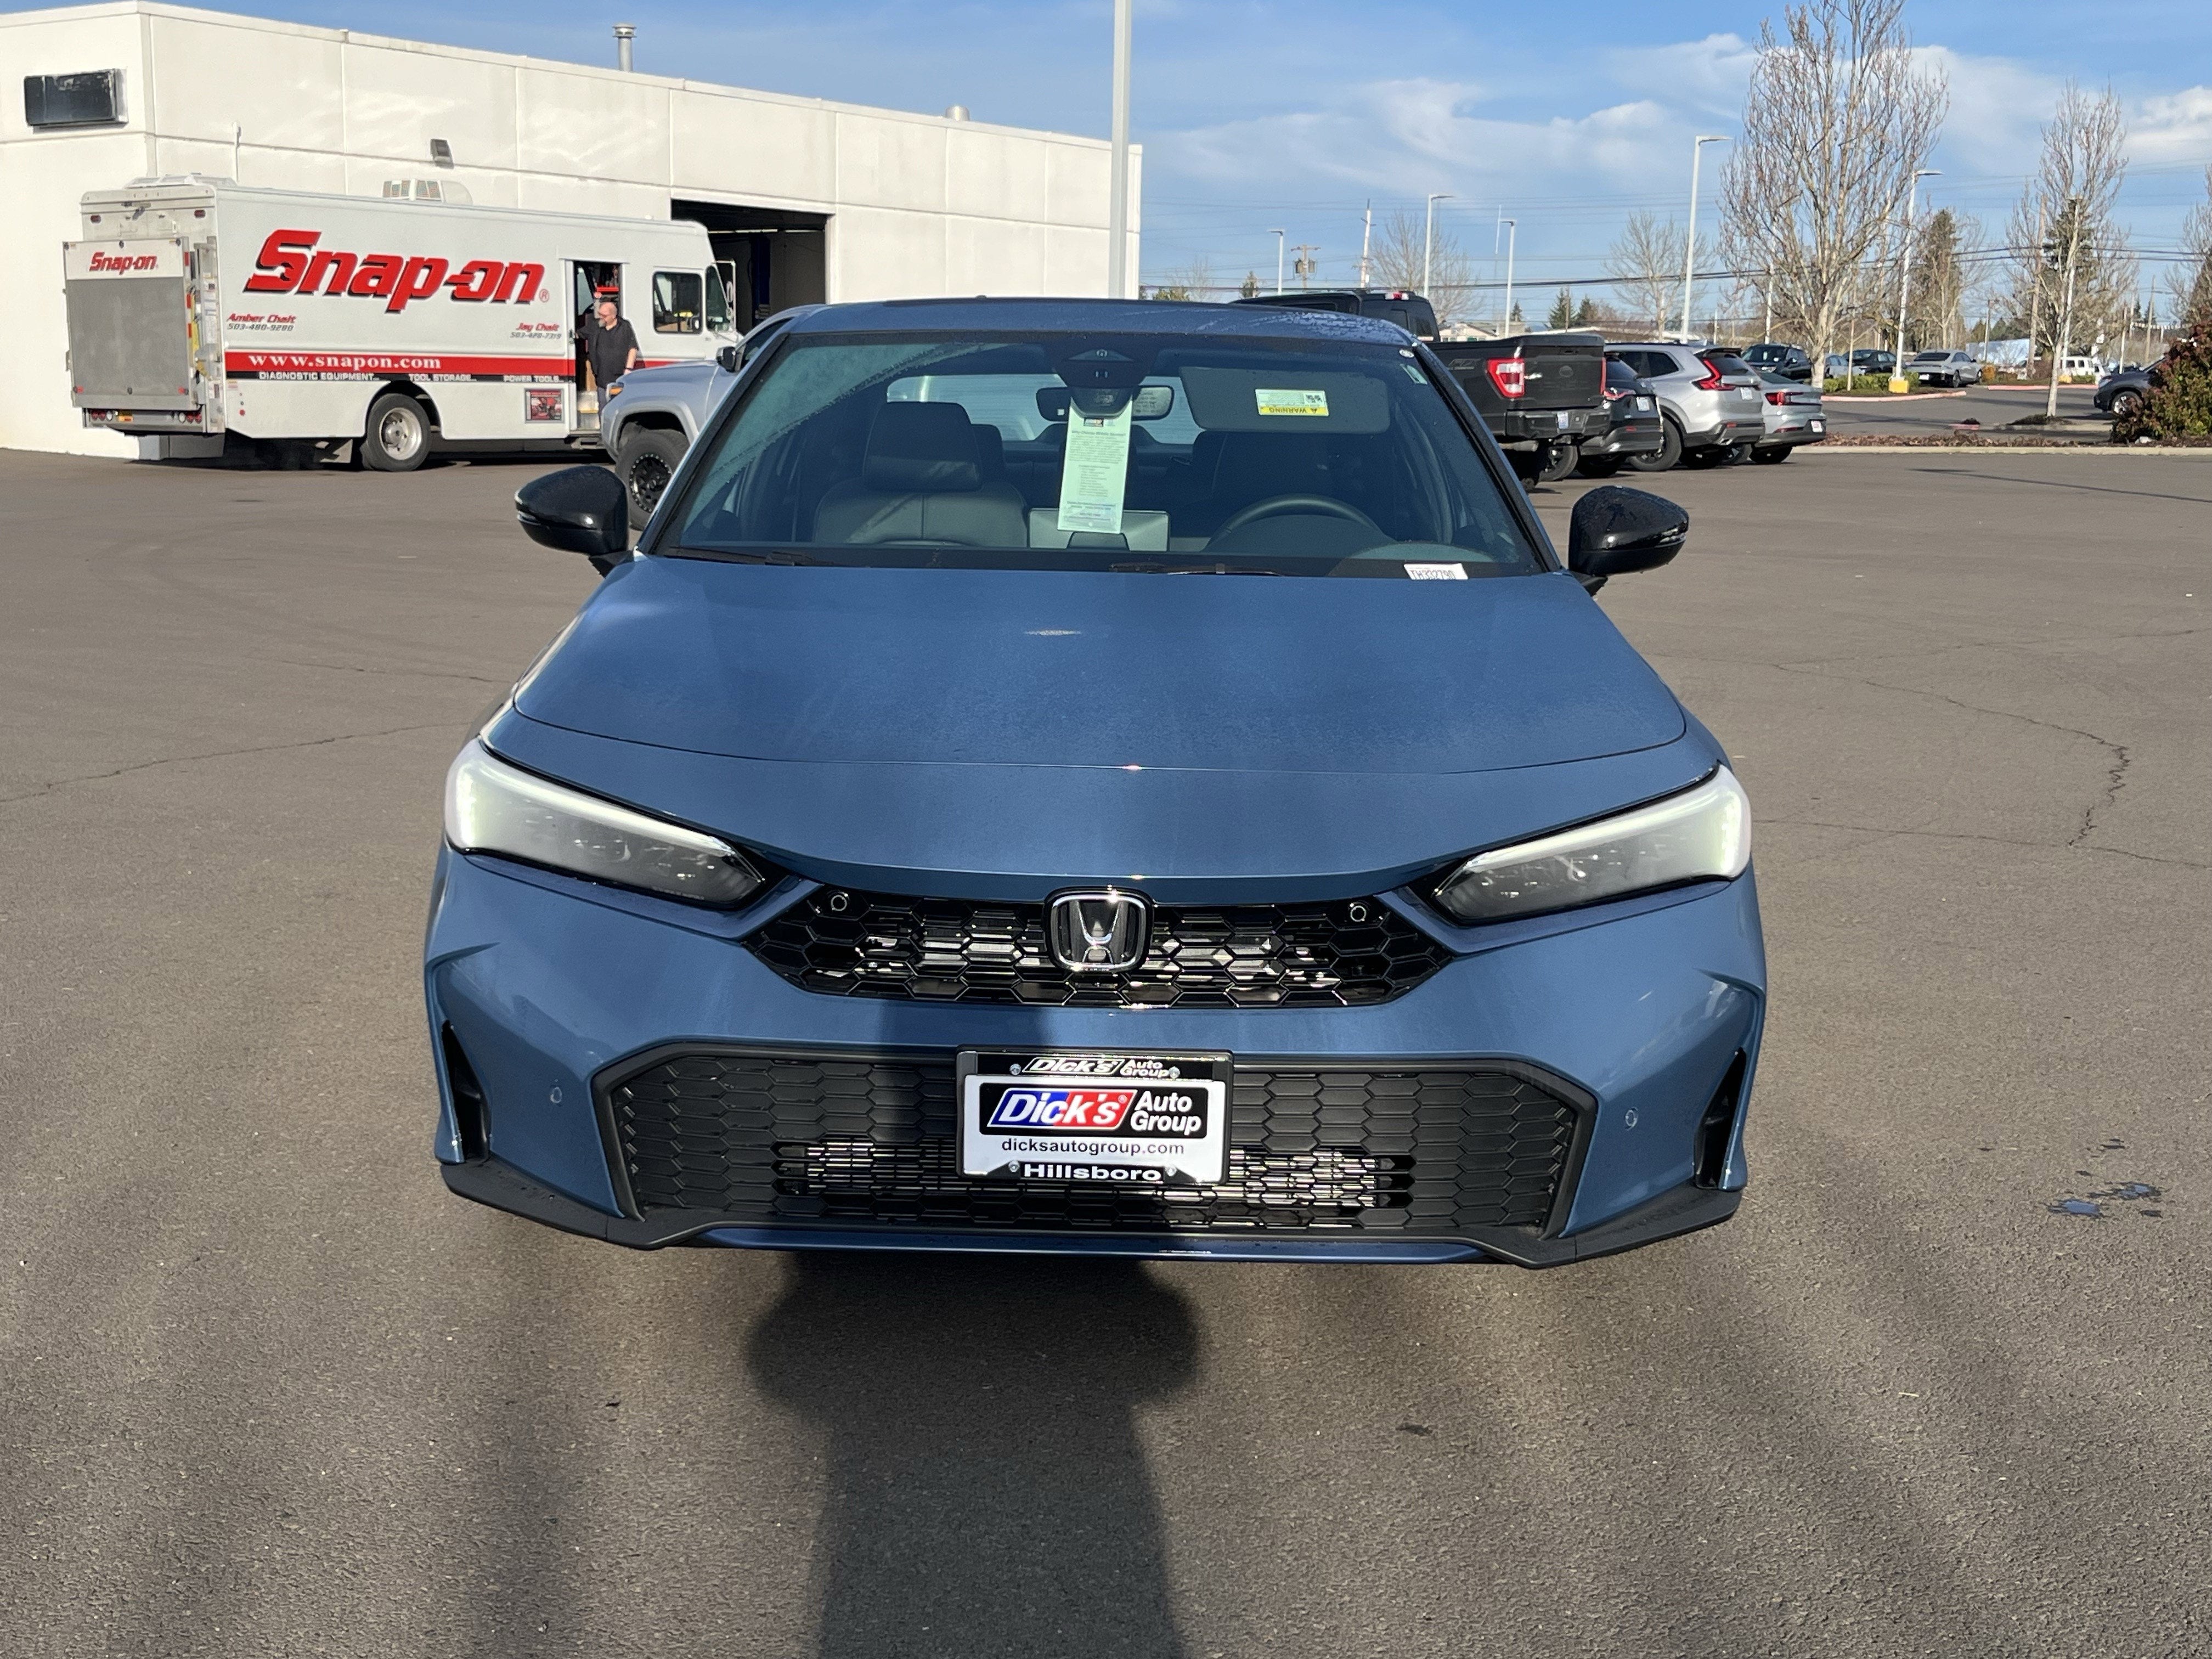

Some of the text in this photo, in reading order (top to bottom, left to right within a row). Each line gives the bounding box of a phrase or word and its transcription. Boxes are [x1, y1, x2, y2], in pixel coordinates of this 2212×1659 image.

[227, 313, 265, 322] Amber
[249, 355, 441, 371] www.snapon.com
[258, 371, 318, 380] DIAGNOSTIC
[1122, 1059, 1163, 1069] Auto
[1120, 1068, 1170, 1078] Group
[1134, 1091, 1192, 1113] Auto
[1130, 1111, 1202, 1135] Group
[1002, 1138, 1184, 1156] dicksautogroup.com
[1024, 1164, 1162, 1180] Hillsboro
